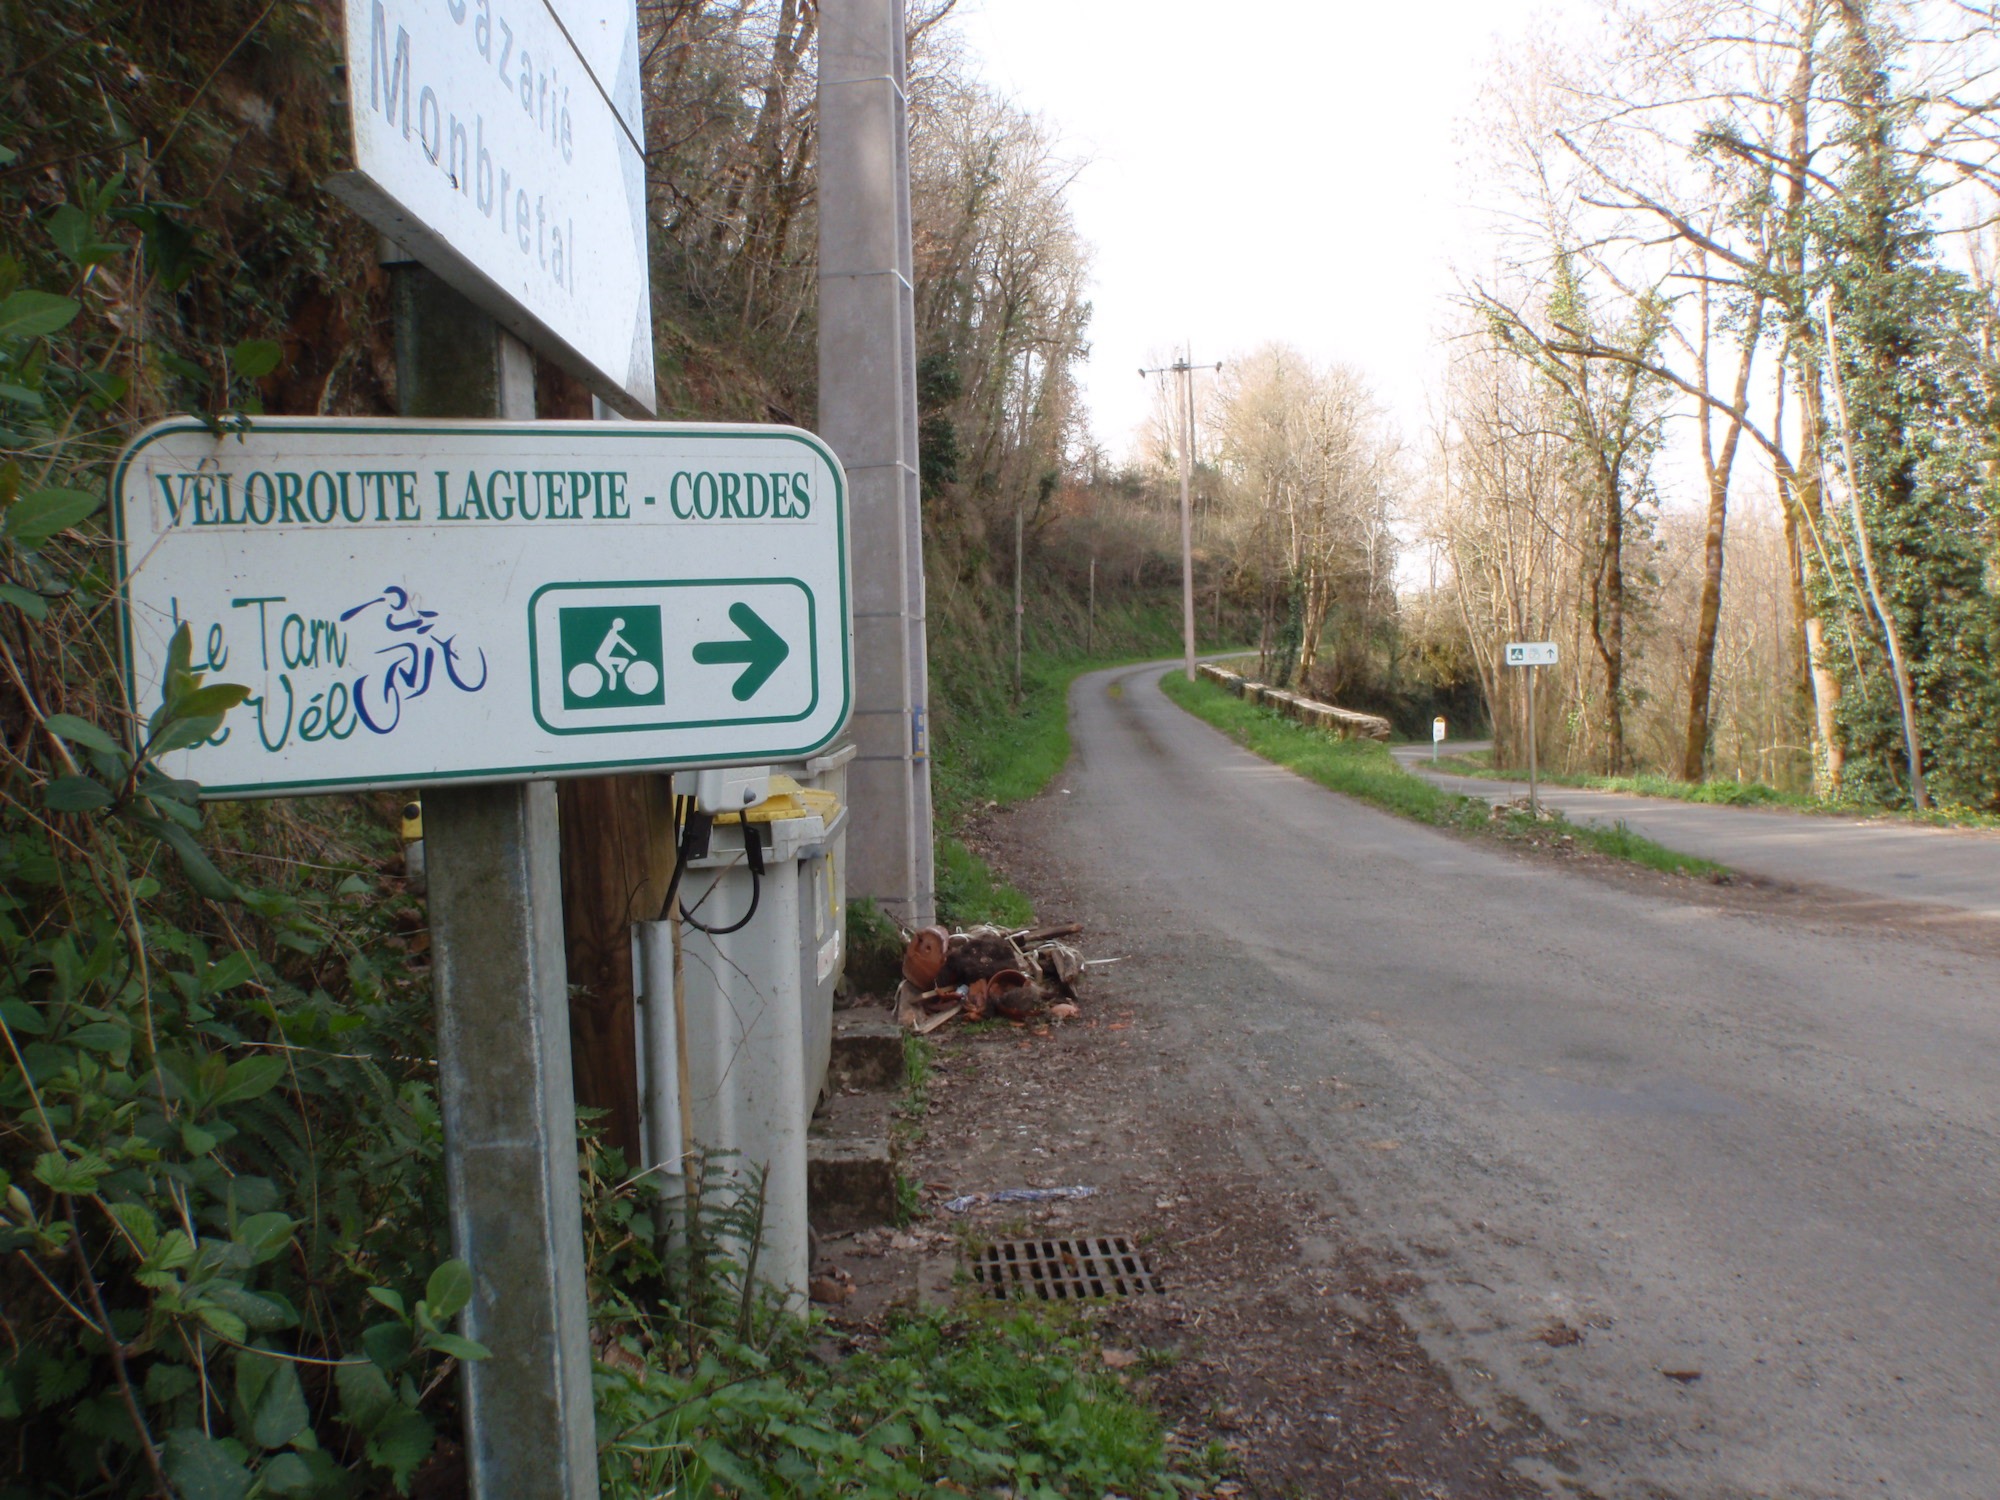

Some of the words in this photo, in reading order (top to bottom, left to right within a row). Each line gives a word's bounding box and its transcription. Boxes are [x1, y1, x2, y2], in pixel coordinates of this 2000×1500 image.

[447, 0, 573, 165] azarié
[371, 1, 574, 298] Monbretal
[434, 470, 631, 521] LAGUEPIE
[670, 471, 811, 520] CORDES
[232, 596, 348, 671] Tarn
